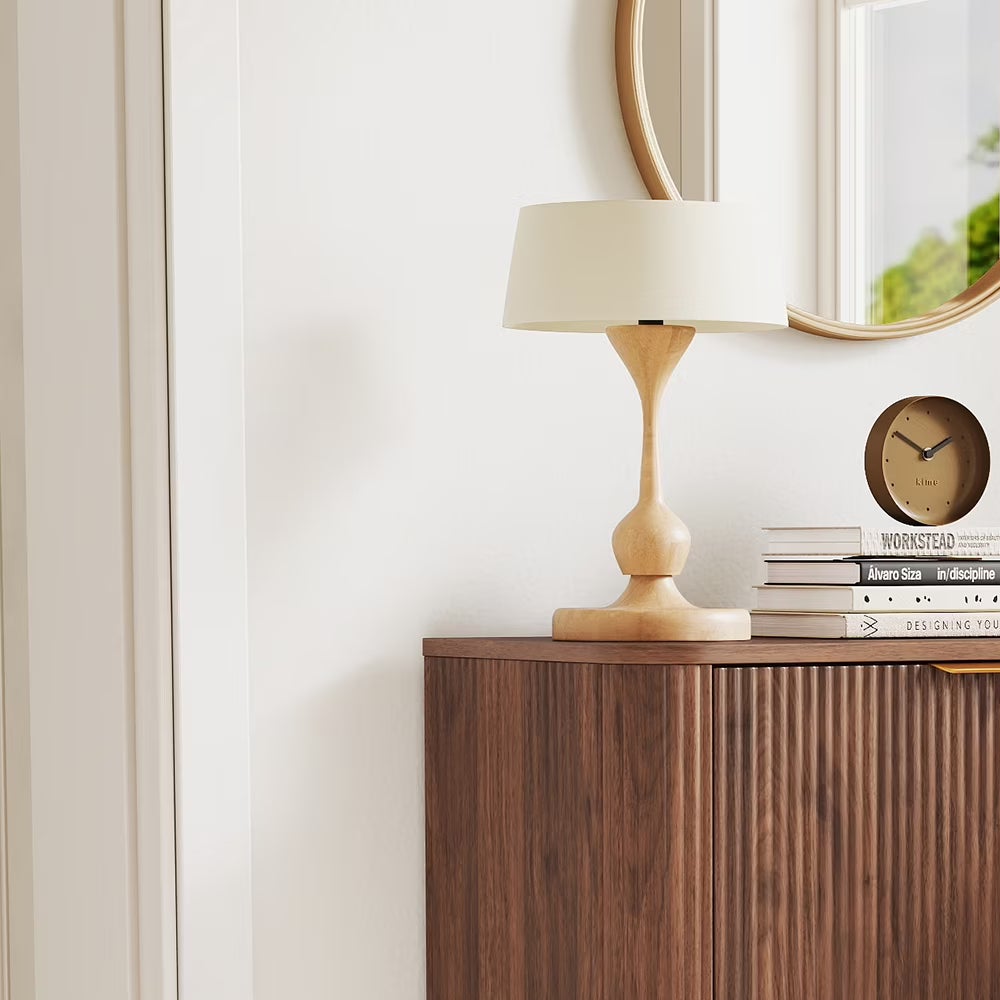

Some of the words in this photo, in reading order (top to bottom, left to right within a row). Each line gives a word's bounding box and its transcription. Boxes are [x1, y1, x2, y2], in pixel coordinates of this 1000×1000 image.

[880, 532, 956, 550] WORKSTEAD
[867, 564, 899, 581] Álvaro
[901, 567, 922, 581] Siza
[936, 565, 996, 582] in/discipline
[906, 619, 971, 631] DESIGNING
